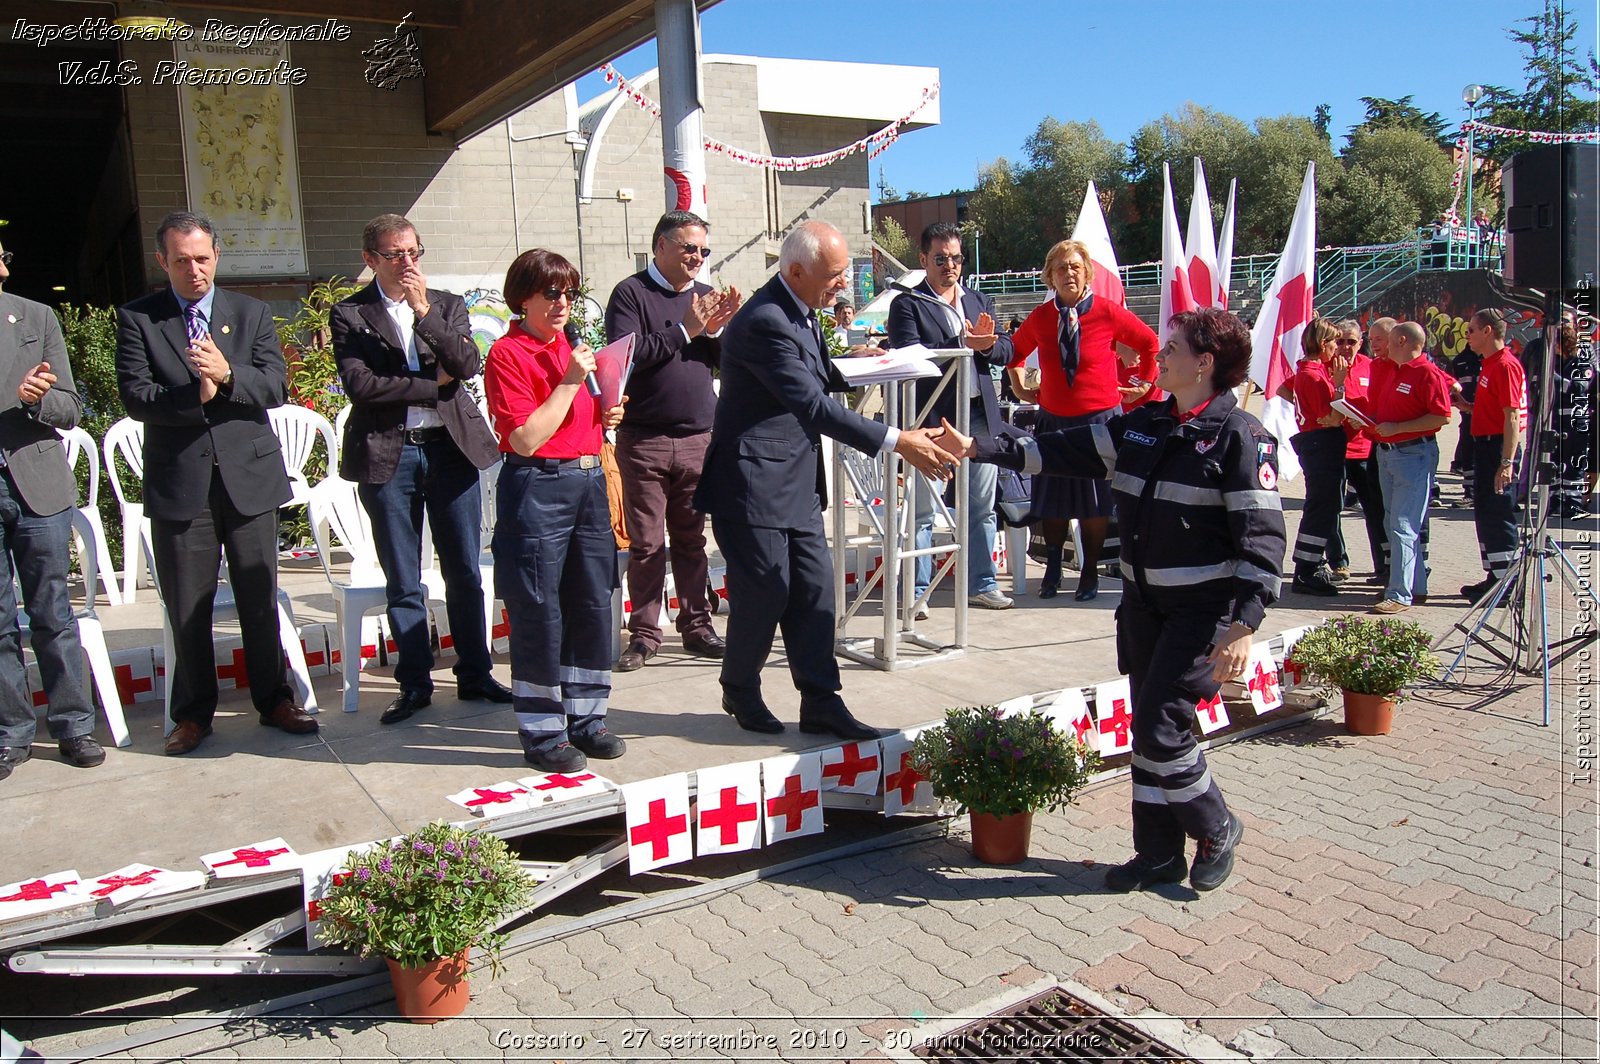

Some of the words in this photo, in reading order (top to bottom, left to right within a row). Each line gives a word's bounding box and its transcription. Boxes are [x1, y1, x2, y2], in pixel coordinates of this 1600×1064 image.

[185, 43, 201, 53] LA
[206, 44, 281, 57] DIFFERENZA
[1129, 433, 1150, 444] SARA
